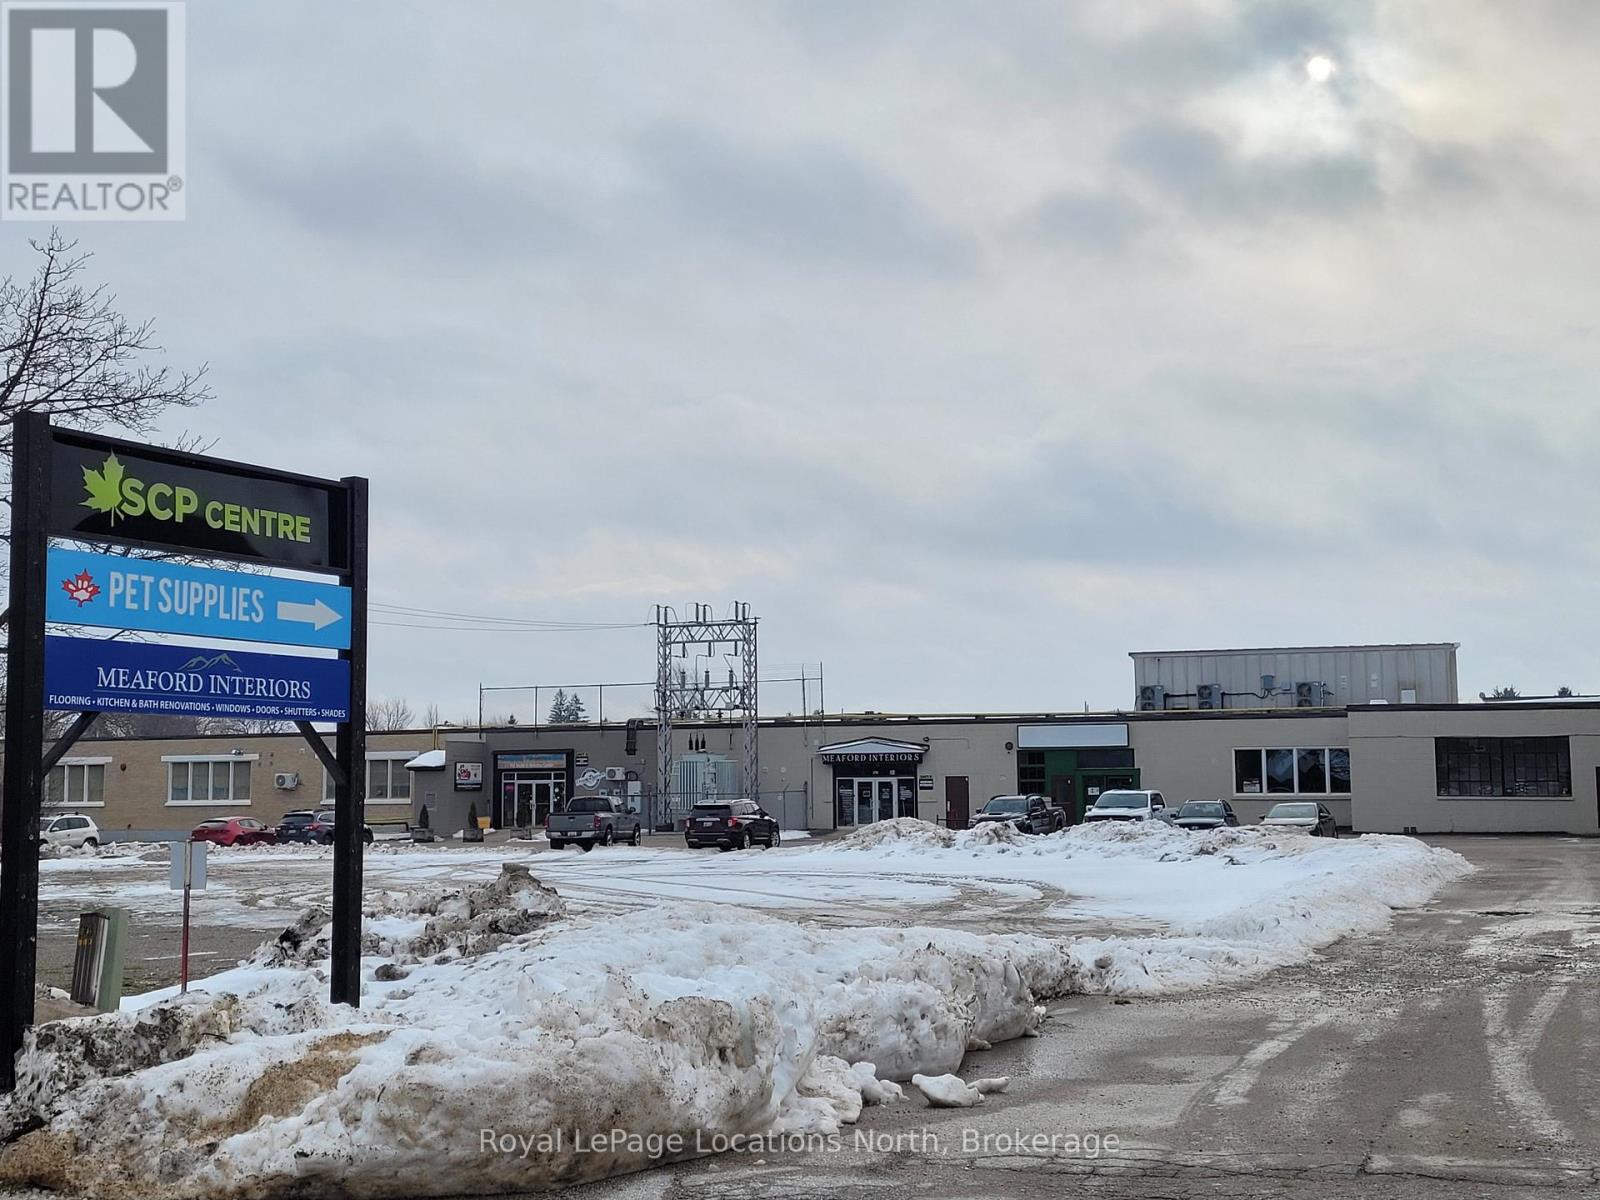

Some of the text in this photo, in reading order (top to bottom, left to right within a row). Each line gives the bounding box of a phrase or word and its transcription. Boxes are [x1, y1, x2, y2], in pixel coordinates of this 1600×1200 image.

[120, 478, 311, 543] SCP CENTRE
[108, 571, 264, 623] PET SUPPLIES
[97, 667, 311, 699] MEAFORD INTERIORS
[49, 695, 346, 718] FLOORING KITCHEN & BATH RENOVATIONS WINDOWS DOORS SHUTTERS SHADES
[822, 753, 920, 762] MEAFORD INTERIORS
